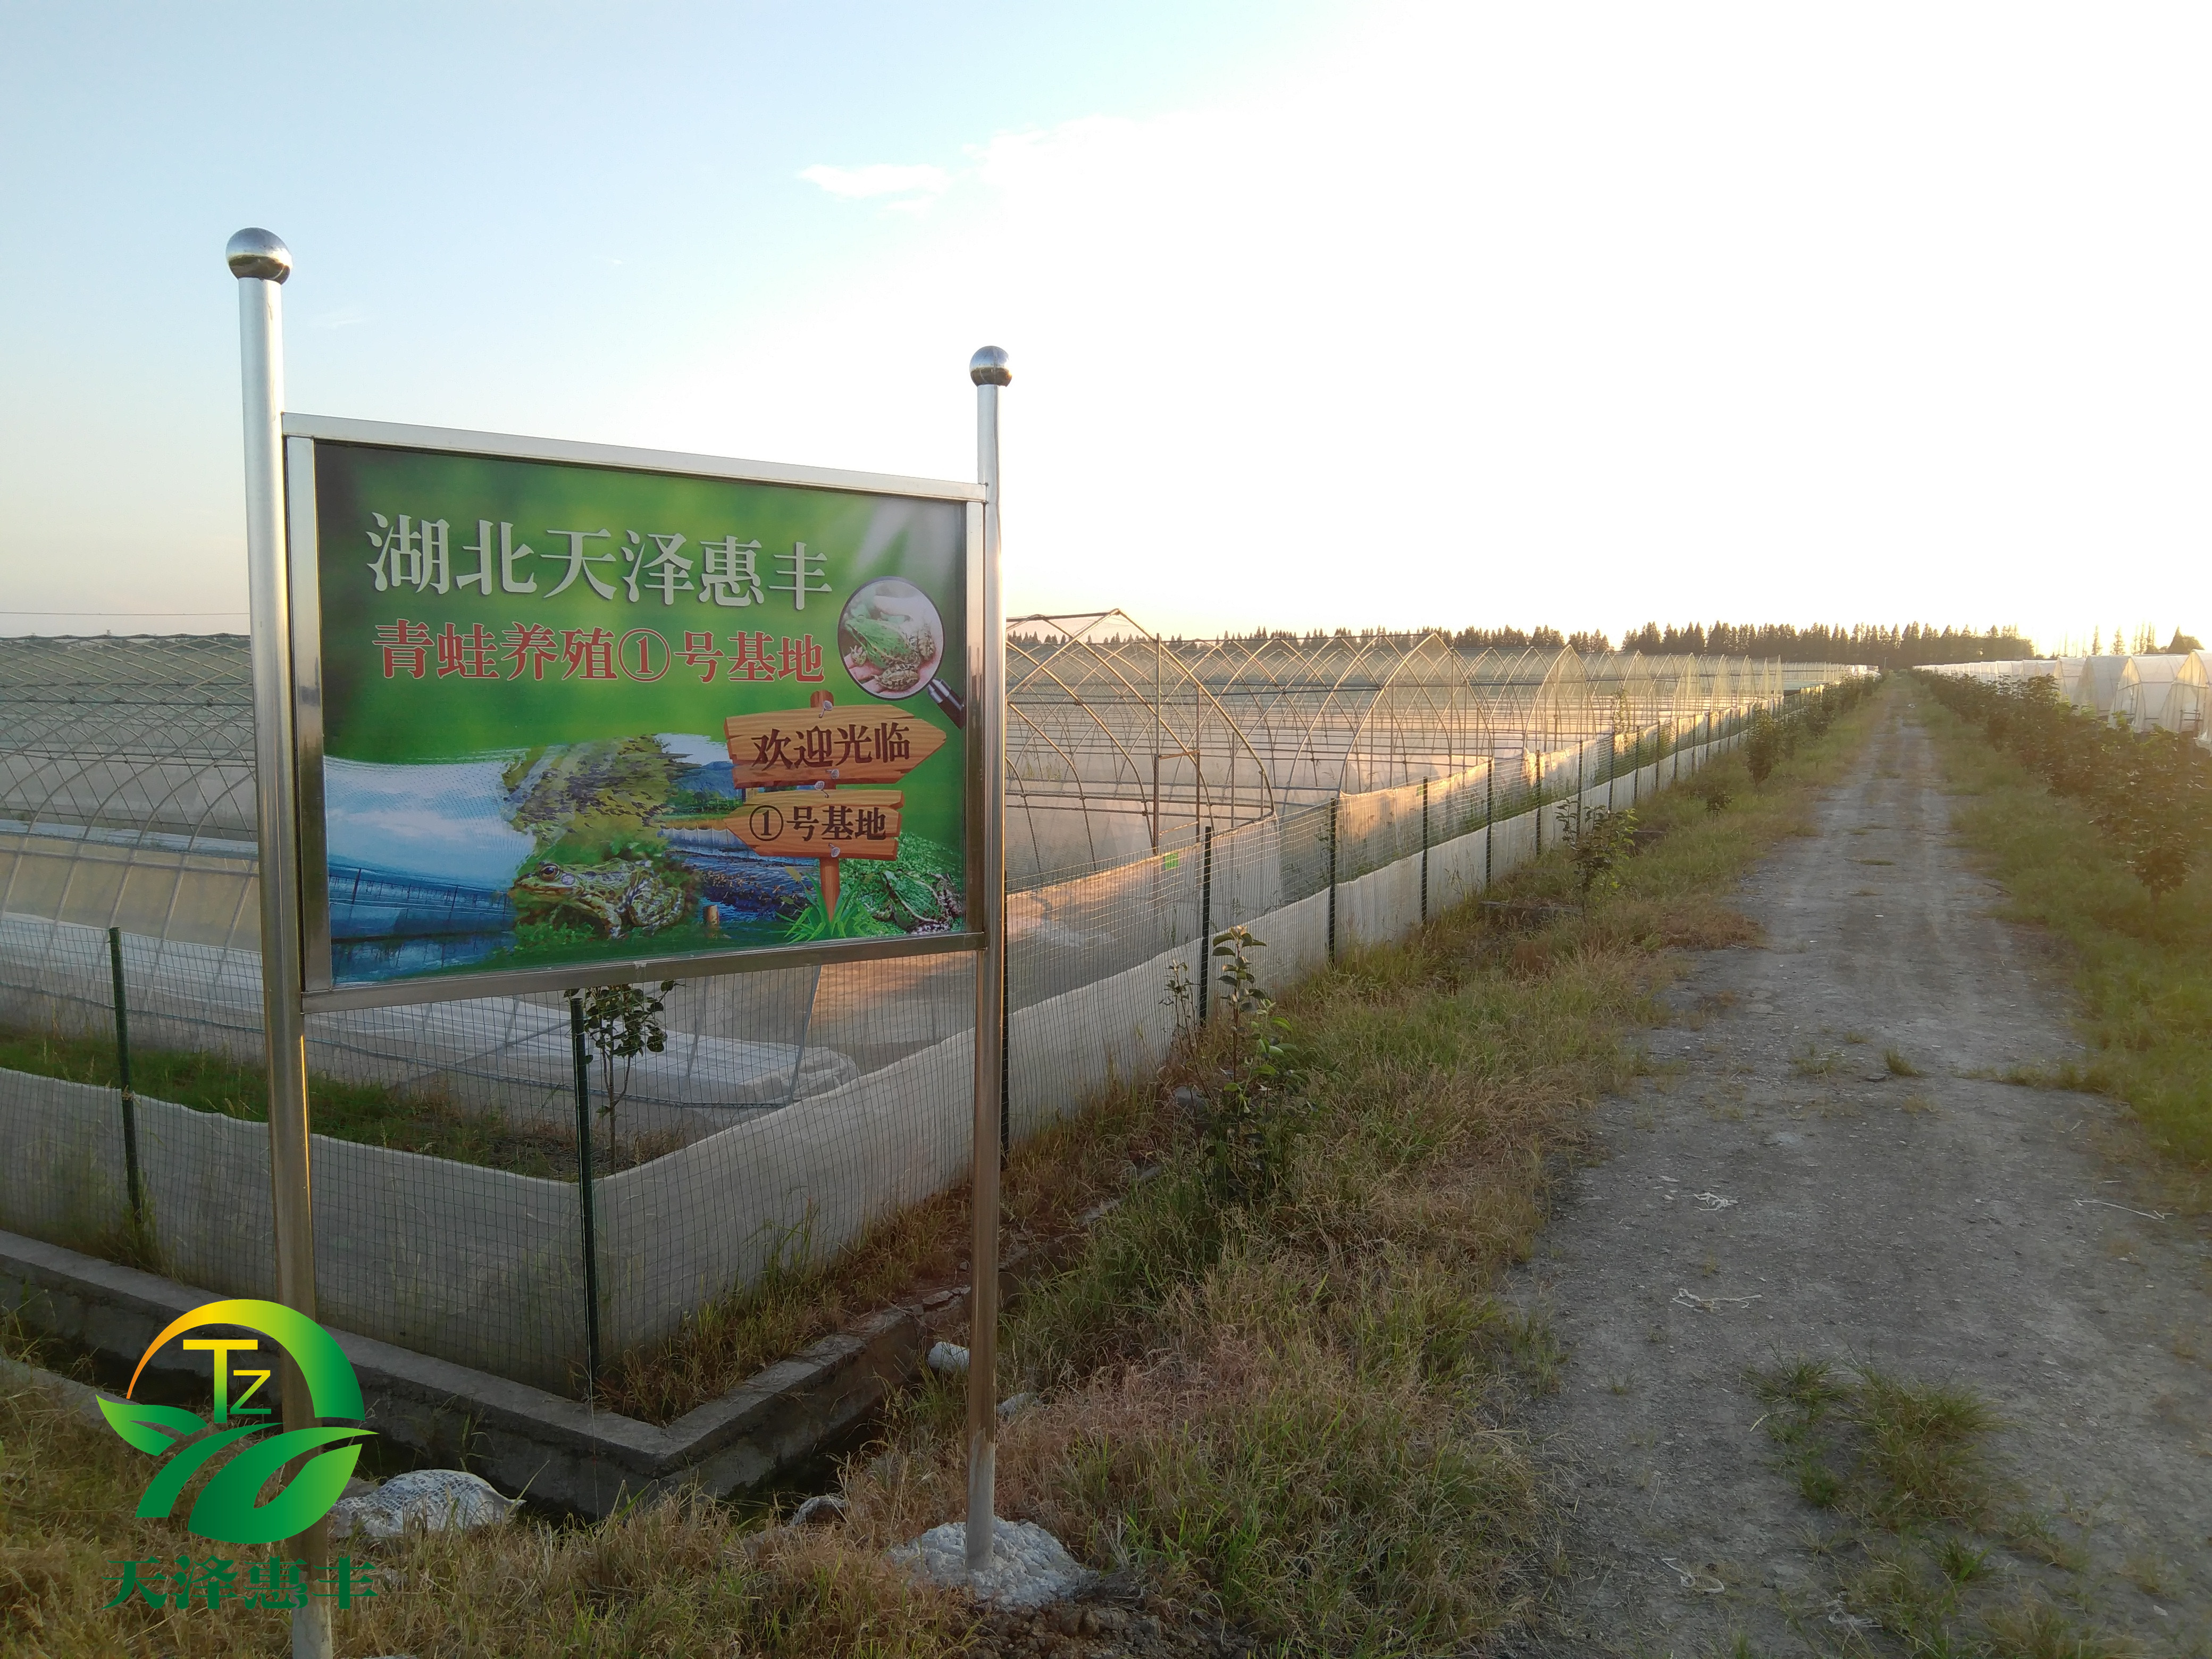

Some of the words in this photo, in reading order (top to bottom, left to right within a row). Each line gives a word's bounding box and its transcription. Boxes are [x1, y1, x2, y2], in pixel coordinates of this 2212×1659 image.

[366, 512, 832, 610] 湖北天泽惠丰
[372, 618, 825, 683] 青蛙养殖①号基地
[750, 722, 910, 771] 欢迎光临
[749, 805, 887, 841] ①号基地
